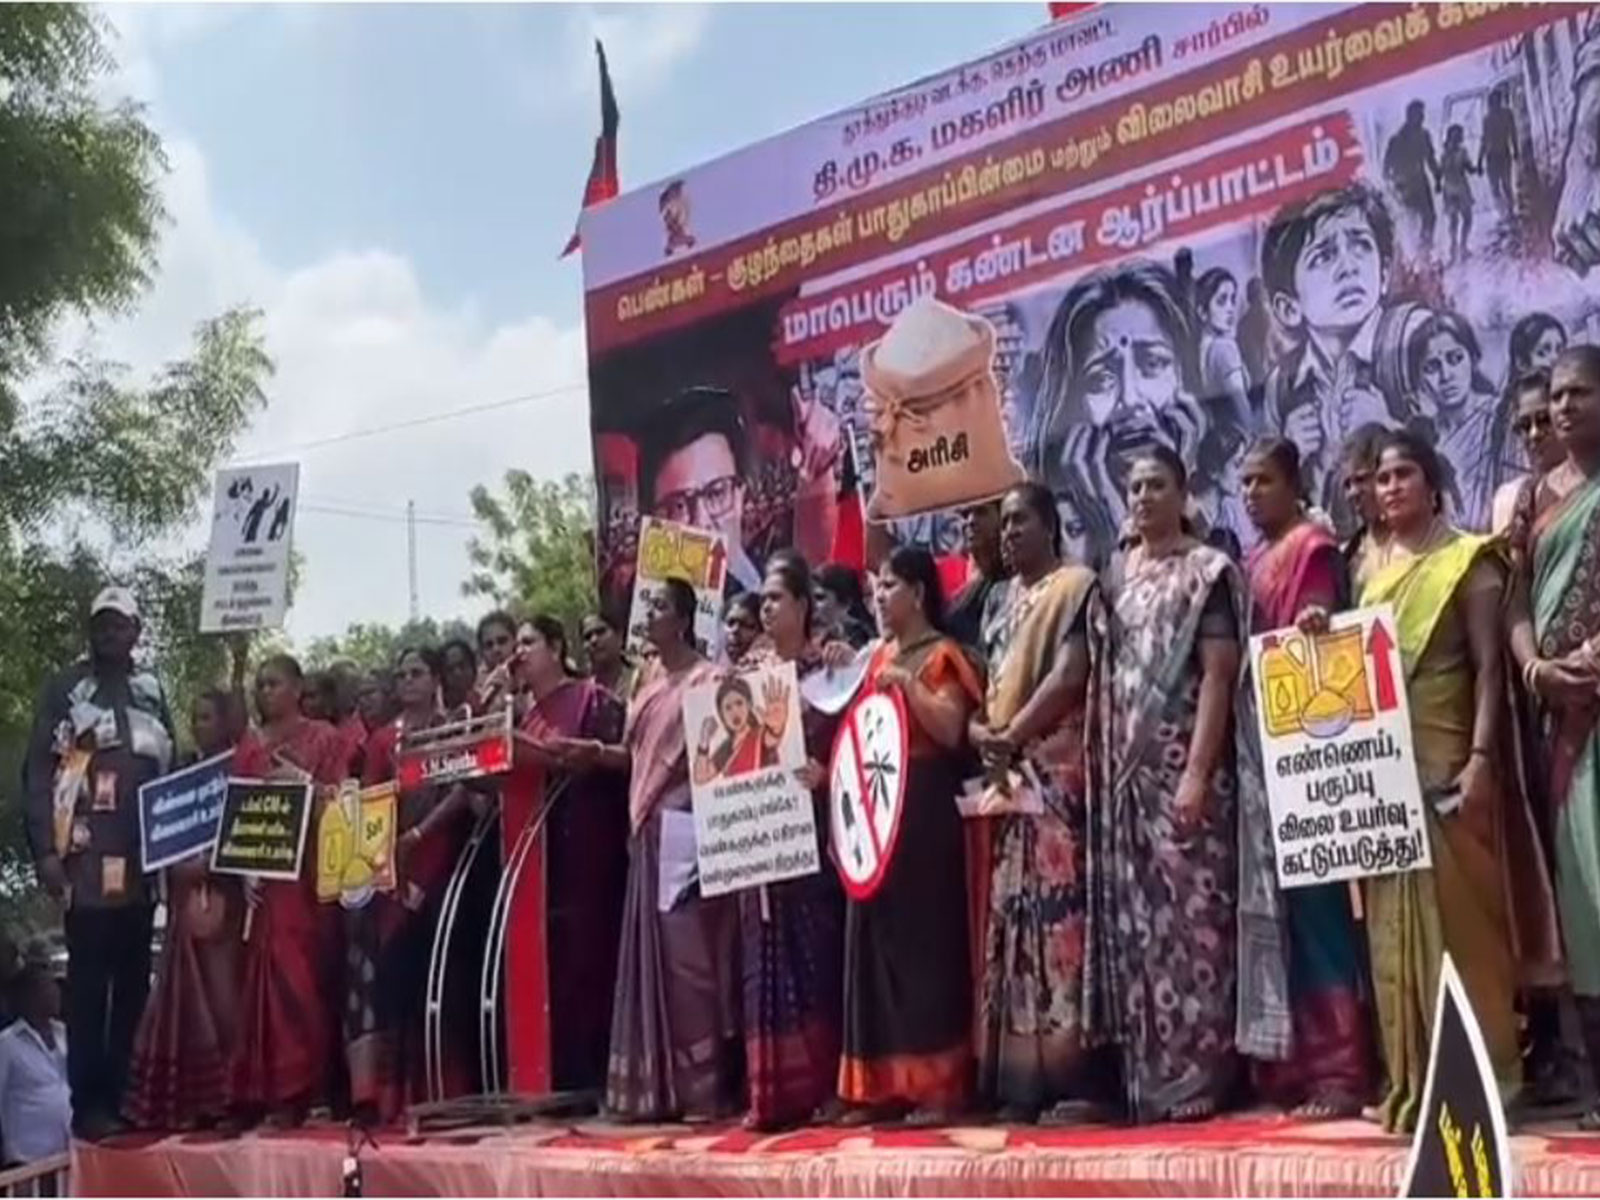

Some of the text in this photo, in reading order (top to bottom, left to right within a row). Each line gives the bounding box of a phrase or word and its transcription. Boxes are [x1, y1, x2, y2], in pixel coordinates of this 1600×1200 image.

[932, 79, 1044, 149] மகளிர்
[1056, 34, 1161, 100] அணி
[1172, 4, 1269, 58] சார்பில்
[617, 265, 705, 320] பெண்கள்
[726, 218, 853, 289] குழந்தைகள்
[857, 150, 1044, 240] பாதுகாப்பின்மை
[1050, 131, 1112, 170] மற்றும்
[1117, 54, 1264, 144] விலைவாசி
[1270, 7, 1431, 84] உயர்வைக்
[945, 221, 1085, 292] கண்டன
[1096, 125, 1338, 247] ஆர்ப்பாட்டம்
[907, 432, 969, 473] அரிசி
[1276, 730, 1401, 777] எண்ணெய்,
[1307, 768, 1375, 805] பருப்பு
[1278, 812, 1334, 842] விலை
[1282, 828, 1424, 876] கட்டுப்படுத்து!
